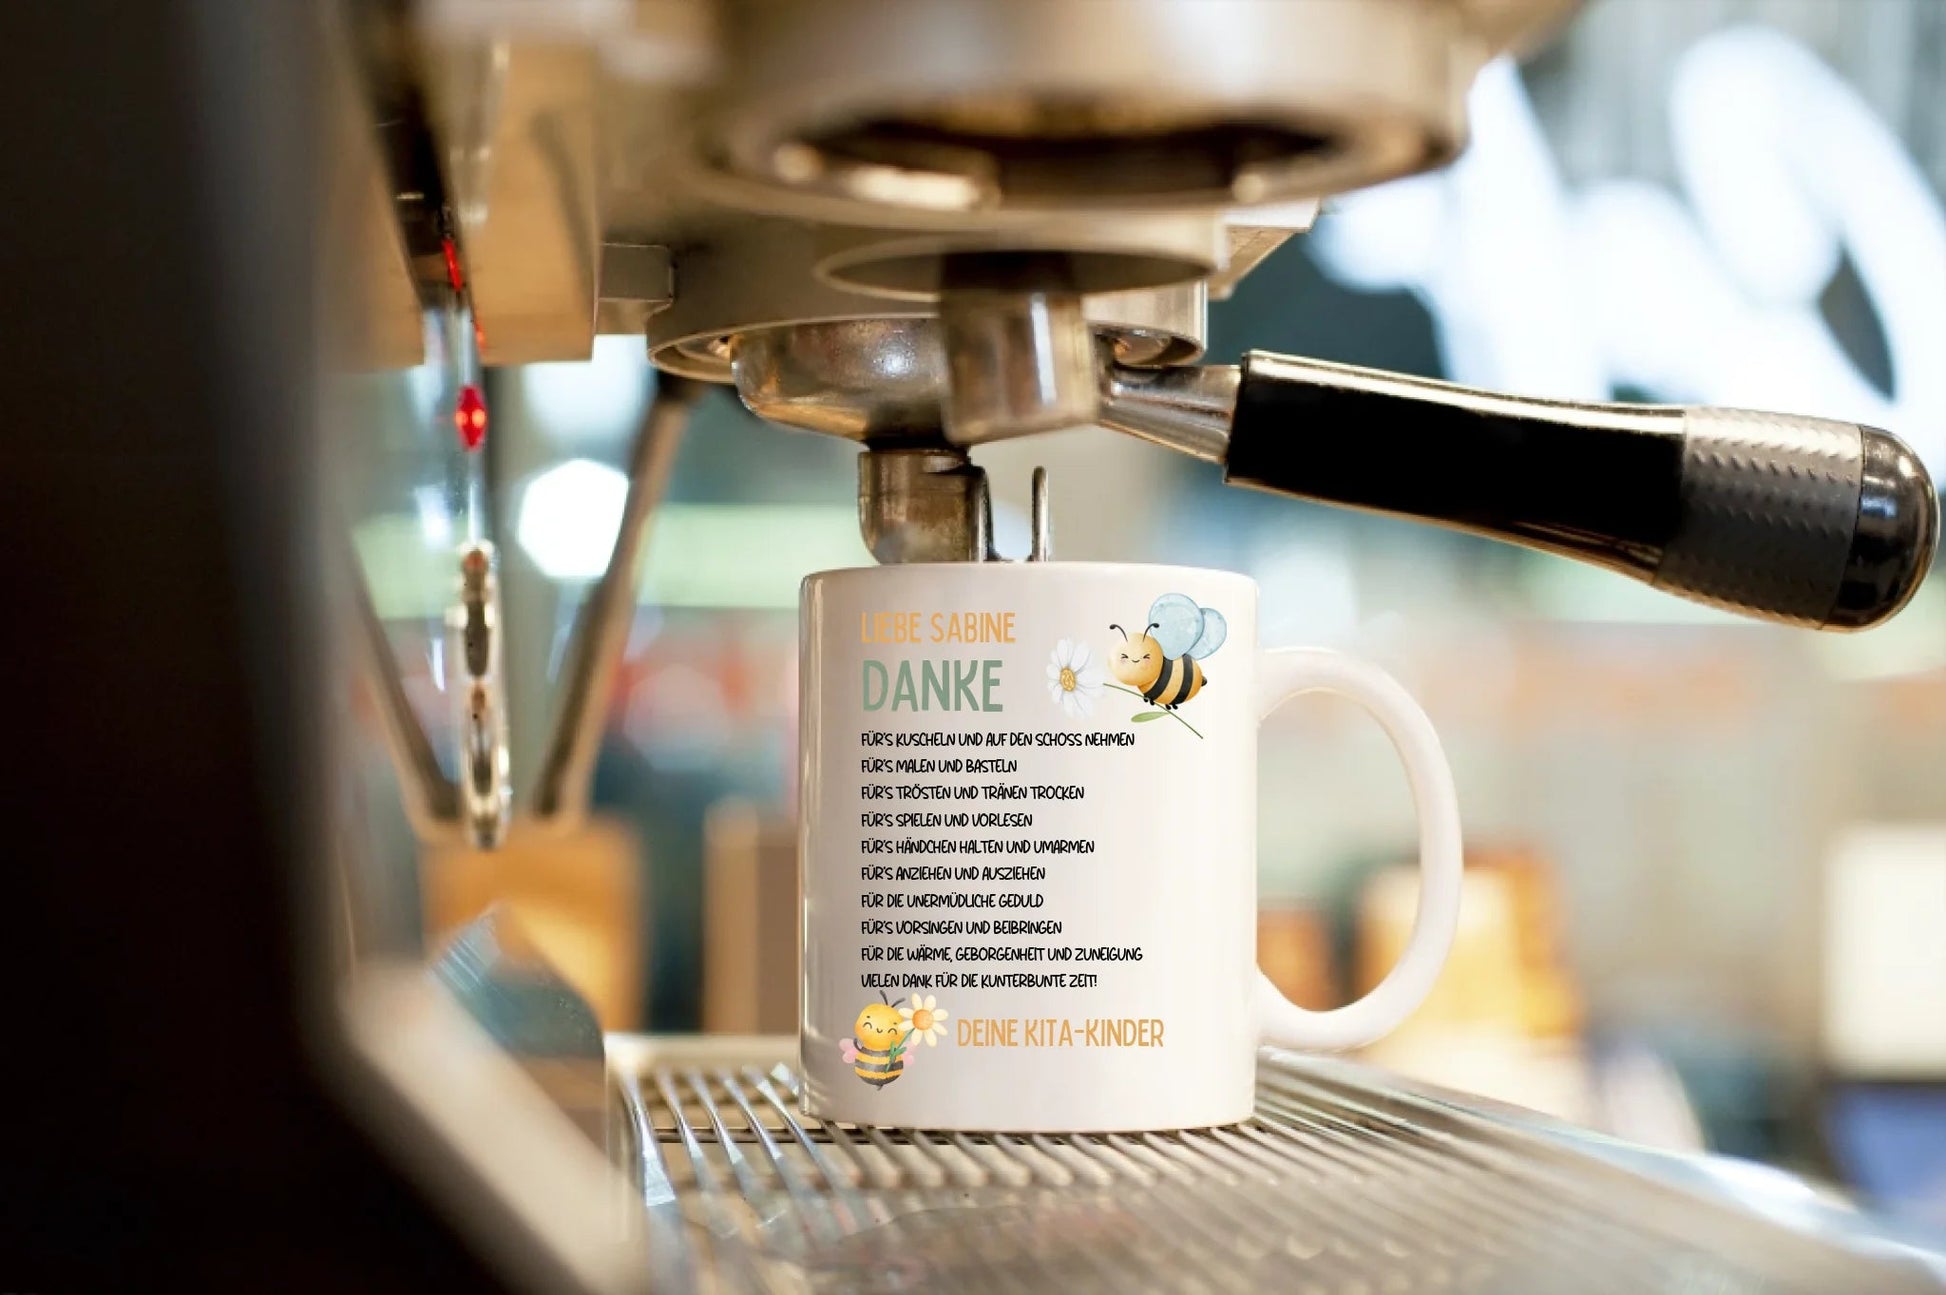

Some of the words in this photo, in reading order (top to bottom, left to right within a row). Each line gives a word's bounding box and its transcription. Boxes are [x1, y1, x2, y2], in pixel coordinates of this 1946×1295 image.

[861, 612, 922, 643] LIEBE
[930, 612, 1016, 643] SABINE
[863, 660, 1003, 712] DANKE
[861, 730, 893, 746] FÜR'S
[896, 732, 955, 747] KUSCHELN
[959, 732, 983, 746] UND
[986, 732, 1007, 747] AUF
[1010, 732, 1032, 746] DEN
[1035, 732, 1082, 746] SCHOSS
[1085, 732, 1135, 746] NEHMEN
[861, 757, 893, 773] FÜR'S
[896, 759, 935, 773] MALEN
[938, 759, 963, 773] UND
[966, 759, 1017, 773] BASTELN
[861, 784, 893, 799] FÜR'S
[895, 784, 951, 799] TRÖSTEN
[954, 786, 978, 799] UND
[981, 783, 1027, 800] TRÄNEN
[1030, 785, 1084, 800] TROCKEN
[861, 811, 893, 827] FÜR'S
[896, 813, 941, 827] SPIELEN
[944, 813, 969, 827] UND
[972, 813, 1032, 827] VORLESEN
[861, 838, 893, 853] FÜR'S
[896, 837, 956, 854] HÄNDCHEN
[959, 840, 1003, 854] HALTEN
[1006, 840, 1031, 853] UND
[1034, 840, 1094, 854] UMARMEN
[862, 864, 893, 880] FÜR'S
[896, 866, 951, 881] ANZIEHEN
[955, 866, 979, 880] UND
[982, 866, 1045, 880] AUSZIEHEN
[862, 892, 884, 908] FÜR
[887, 894, 904, 908] DIE
[907, 892, 996, 908] UNERMÜDLICHE
[999, 894, 1044, 908] GEDULD
[861, 919, 893, 934] FÜR'S
[896, 920, 963, 934] VORSINGEN
[966, 920, 990, 934] UND
[994, 920, 1062, 934] BEIBRINGEN
[862, 945, 884, 961] FÜR
[887, 947, 904, 961] DIE
[907, 944, 952, 963] WÄRME,
[955, 947, 1045, 961] GEBORGENHEIT
[1048, 947, 1072, 961] UND
[1075, 947, 1143, 961] ZUNEIGUNG
[861, 974, 899, 988] VIELEN
[902, 973, 932, 988] DANK
[935, 972, 958, 987] FÜR
[961, 974, 978, 987] DIE
[981, 974, 1066, 989] KUNTERBUNTE
[1069, 974, 1097, 987] ZEIT!
[958, 1018, 1018, 1047] DEINE
[1024, 1018, 1164, 1047] KITA-KINDER
